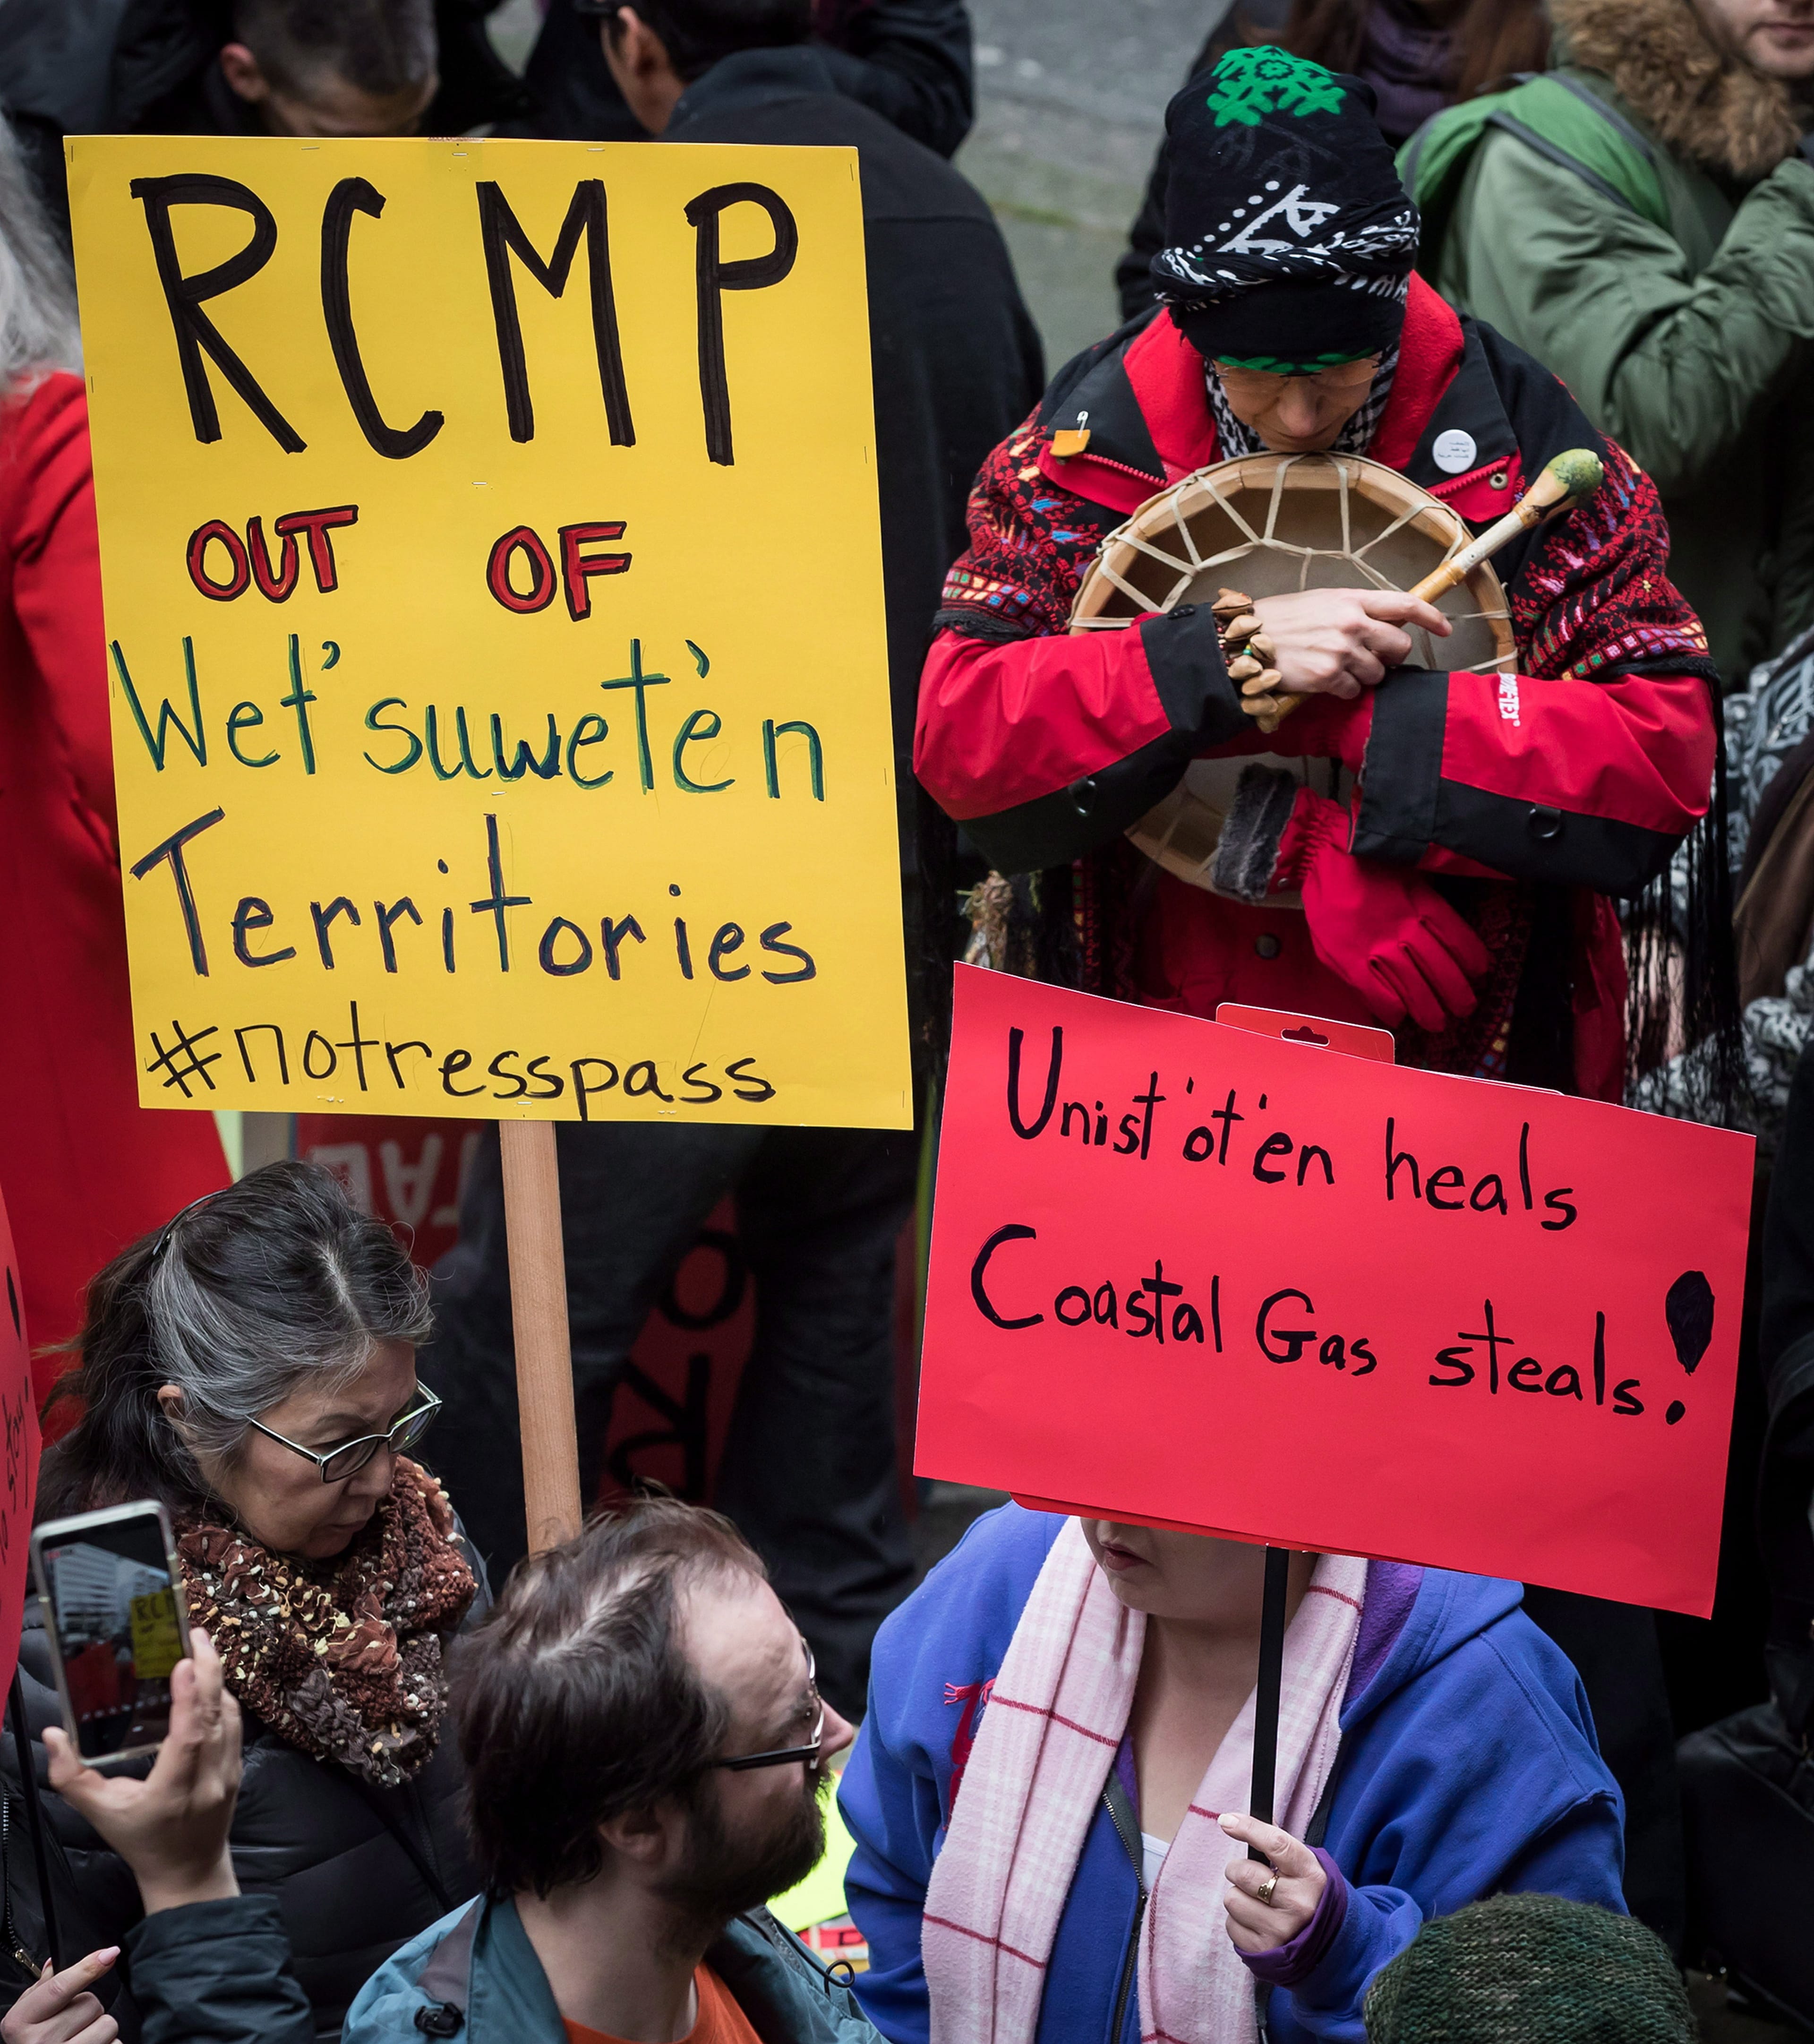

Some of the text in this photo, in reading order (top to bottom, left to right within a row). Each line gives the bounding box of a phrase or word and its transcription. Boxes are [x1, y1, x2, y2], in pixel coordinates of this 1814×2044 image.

[129, 173, 798, 466] RCMP
[186, 504, 632, 622] OUT OF
[129, 806, 816, 984] Territories
[147, 1001, 776, 1120] #notresspass
[1008, 1026, 1577, 1231] Unist'ot'en heals
[971, 1224, 1715, 1425] Coastal Gas steals!
